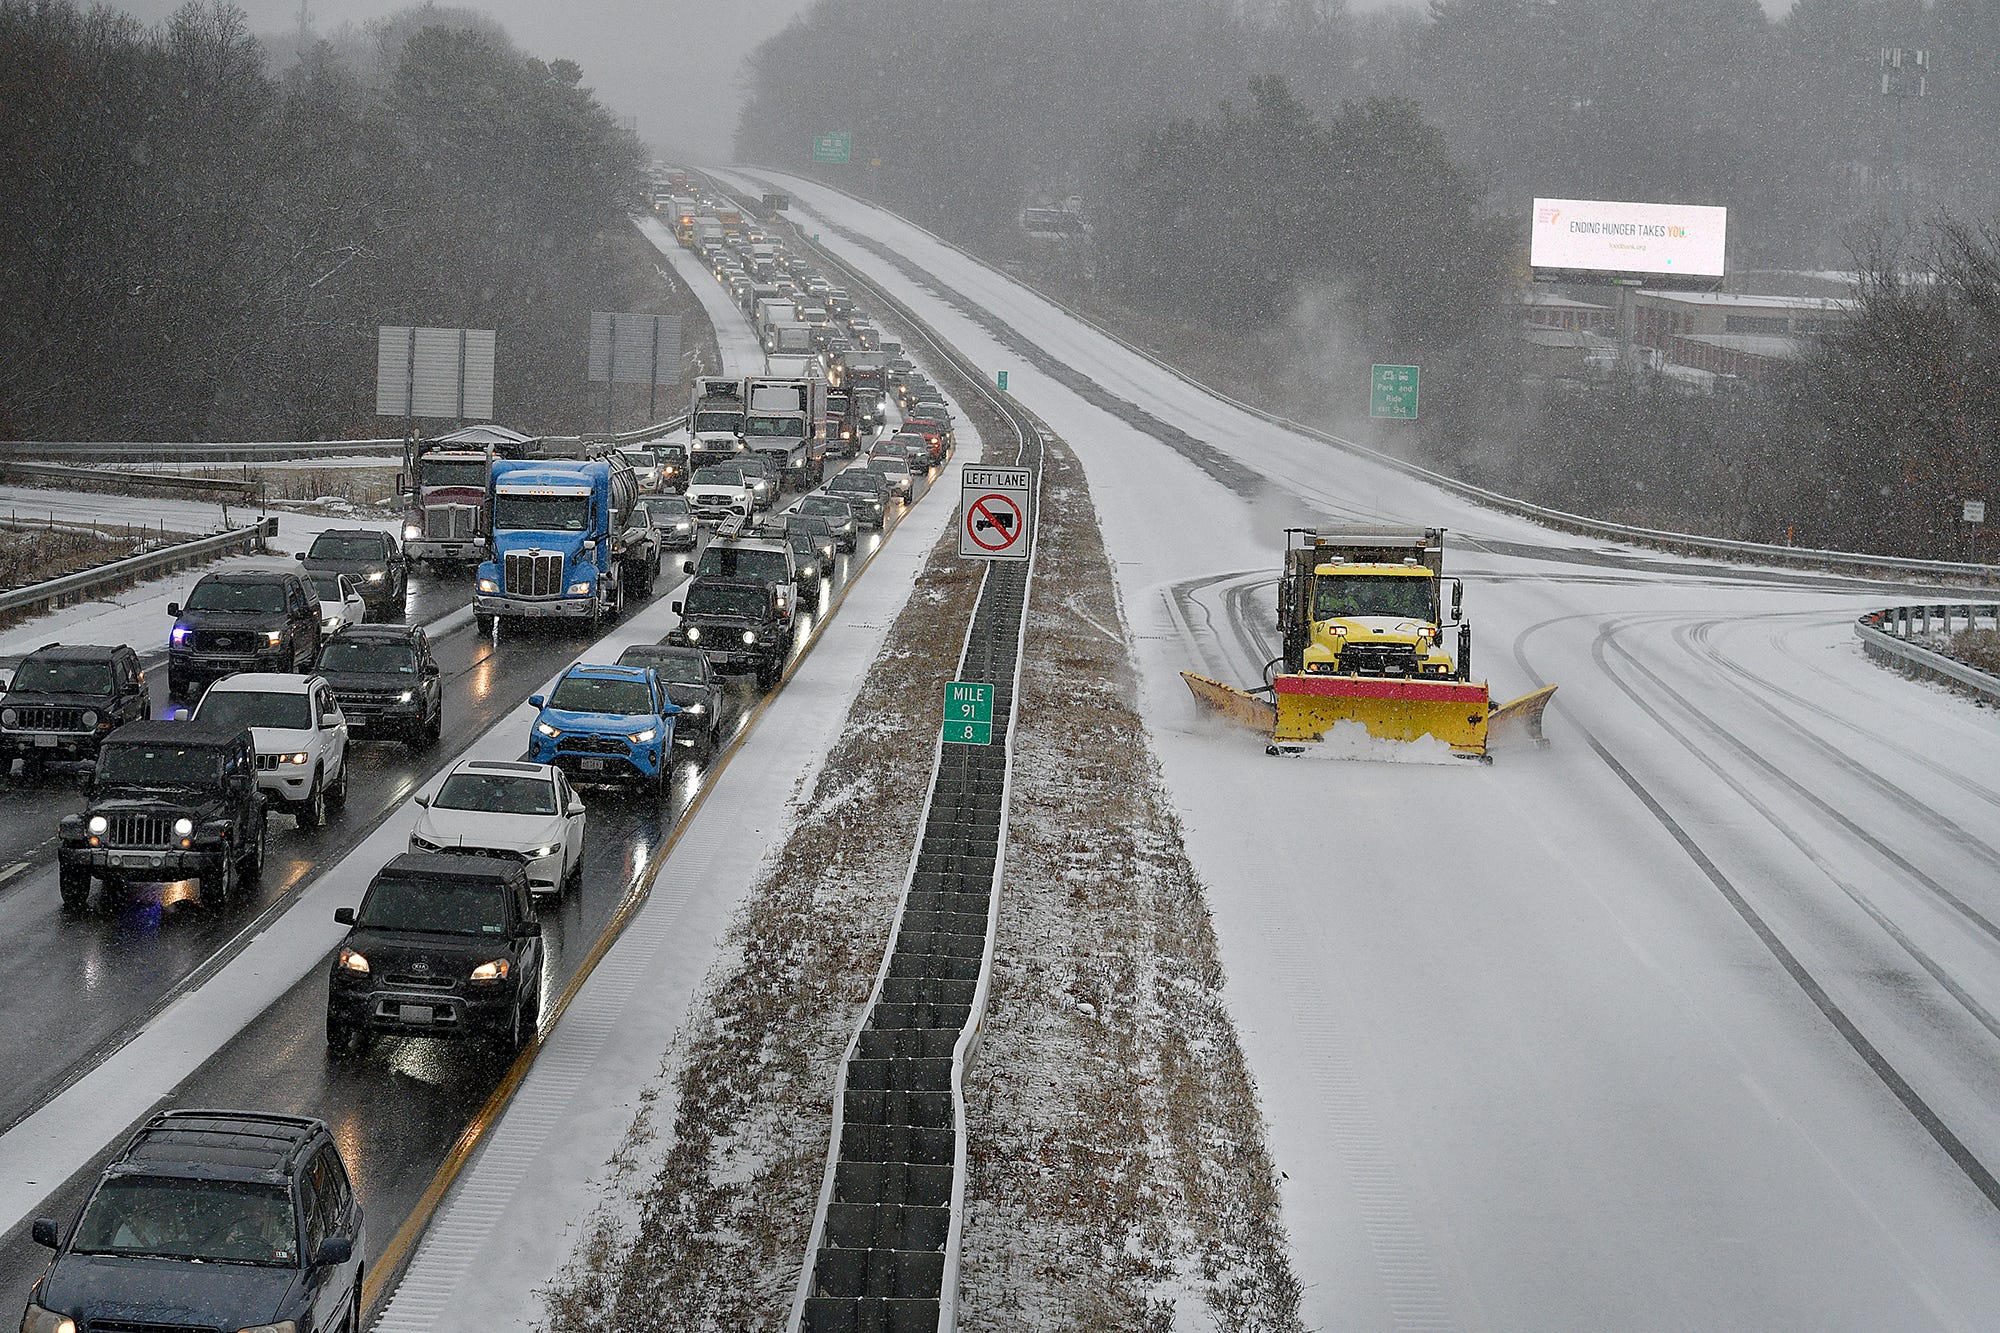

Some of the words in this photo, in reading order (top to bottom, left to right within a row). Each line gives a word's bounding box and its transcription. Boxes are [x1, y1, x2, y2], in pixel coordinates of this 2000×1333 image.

[1570, 221, 1600, 234] ENDING
[1602, 223, 1636, 236] HUNGER
[1638, 224, 1666, 237] TAKES
[1377, 383, 1394, 391] Park
[1393, 406, 1406, 414] 94
[966, 472, 992, 485] LEFT
[997, 473, 1026, 487] LANE
[953, 686, 984, 702] MILE
[961, 704, 975, 718] 91
